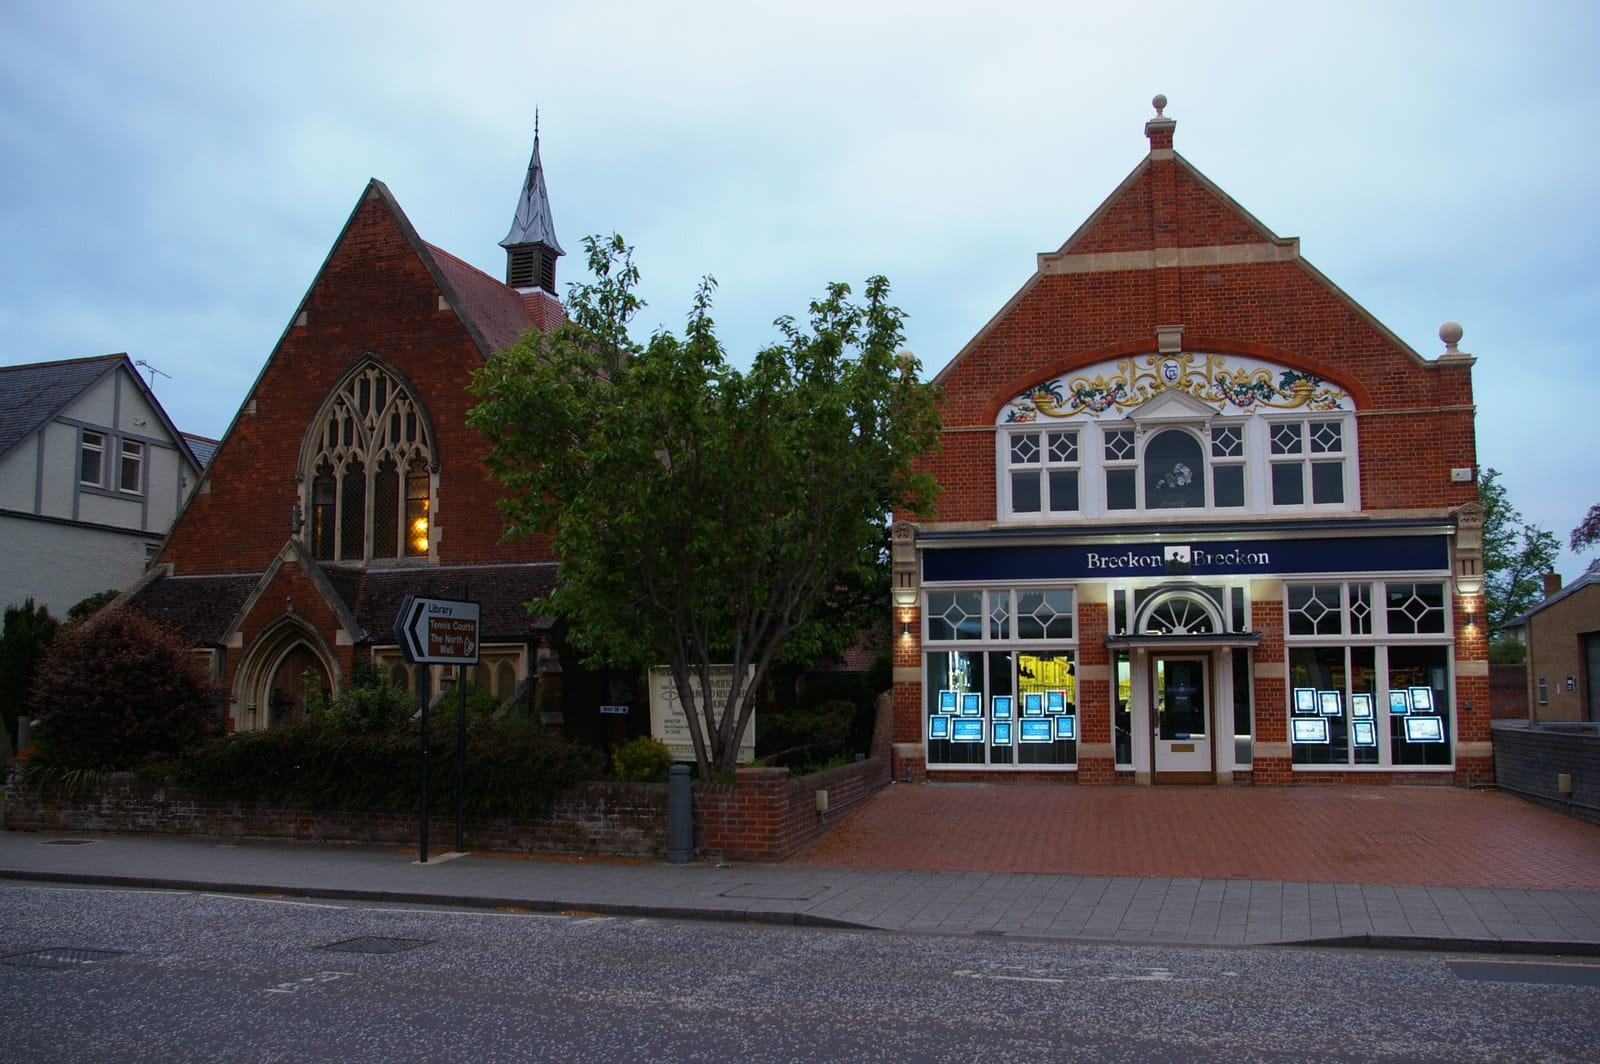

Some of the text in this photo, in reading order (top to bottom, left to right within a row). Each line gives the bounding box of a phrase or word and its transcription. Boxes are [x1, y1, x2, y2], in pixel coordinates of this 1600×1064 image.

[1087, 551, 1163, 569] Breckon
[1192, 548, 1270, 566] Breckon
[429, 604, 453, 616] Library
[431, 620, 474, 632] Tennis Courts
[431, 633, 464, 644] The North
[440, 645, 455, 655] Wall
